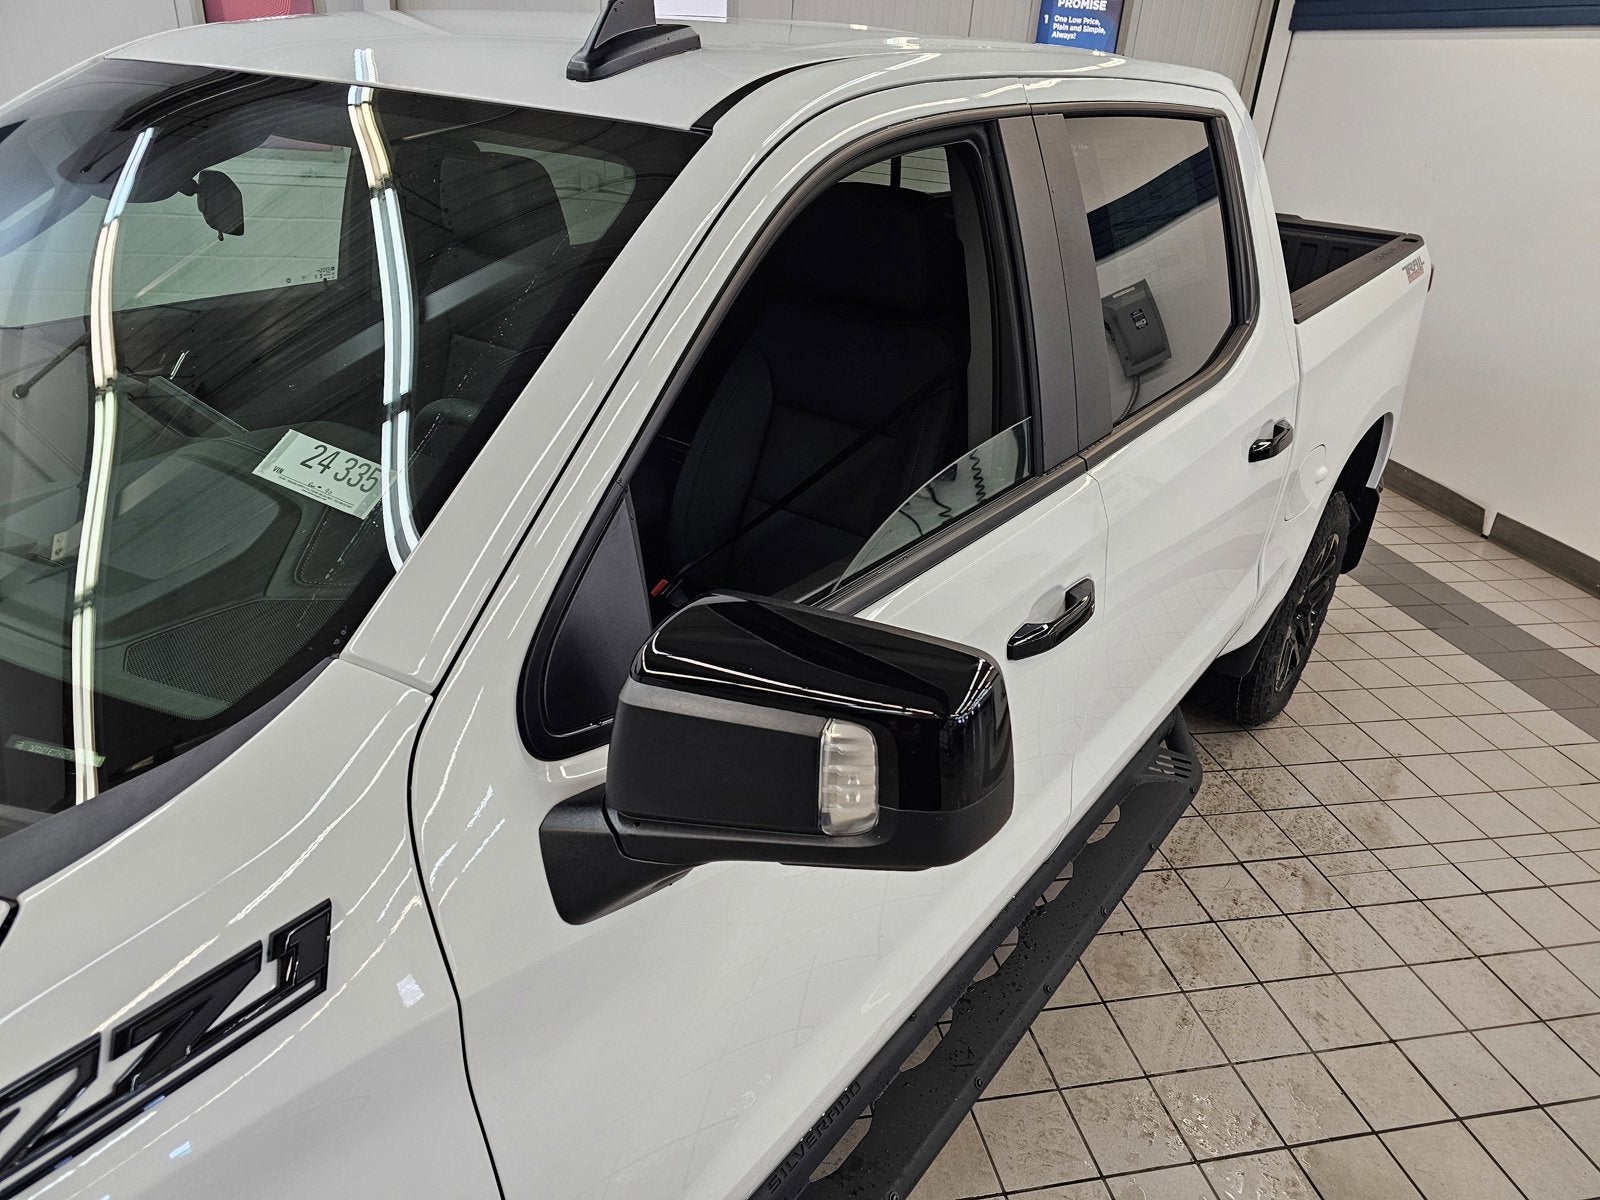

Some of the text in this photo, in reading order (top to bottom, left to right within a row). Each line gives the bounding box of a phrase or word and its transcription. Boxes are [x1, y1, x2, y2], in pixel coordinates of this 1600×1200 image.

[1057, 0, 1107, 11] PROMISE
[1044, 14, 1049, 24] 1
[1068, 16, 1082, 24] Low
[1082, 17, 1101, 26] Price,
[1053, 23, 1069, 32] Plain
[1082, 25, 1106, 35] Simple,
[1051, 31, 1076, 40] Always!
[1402, 256, 1425, 274] TRAIL
[273, 466, 285, 475] VIN
[766, 1080, 862, 1194] SILVERADO
